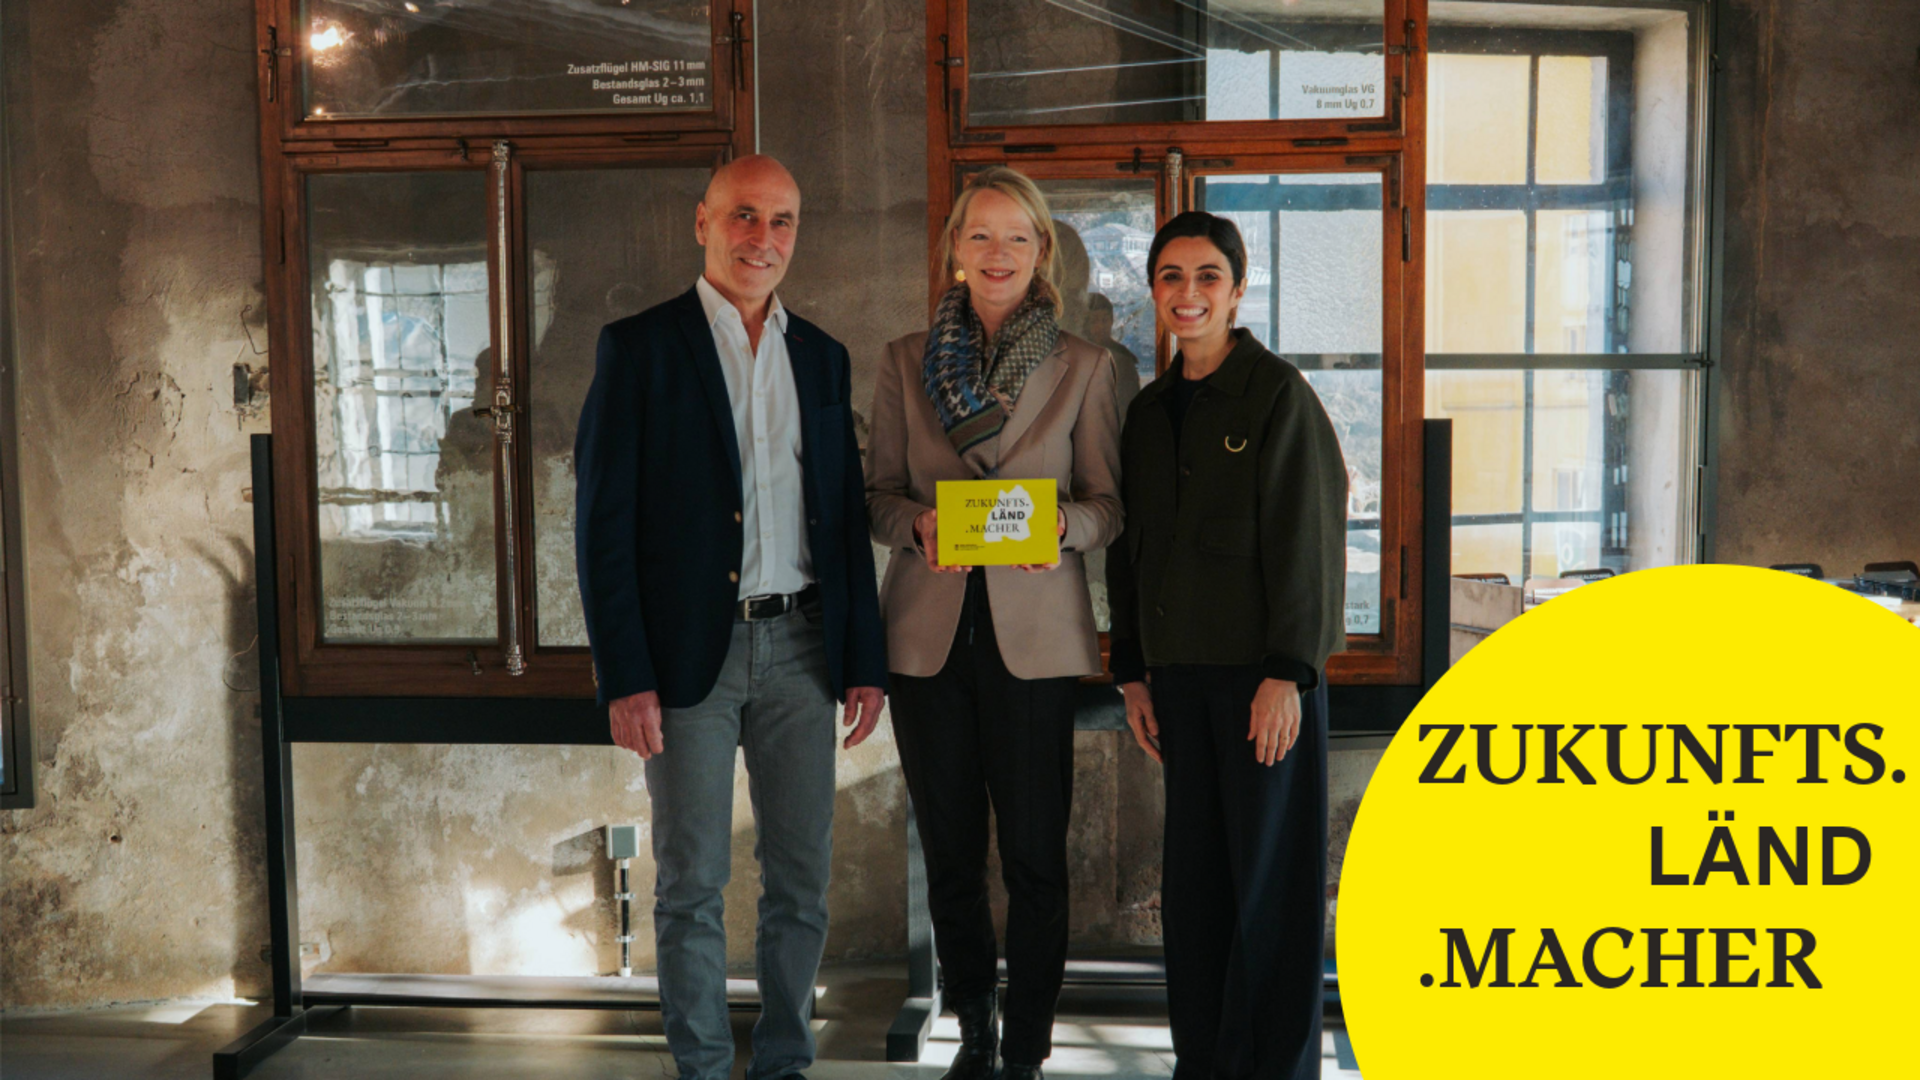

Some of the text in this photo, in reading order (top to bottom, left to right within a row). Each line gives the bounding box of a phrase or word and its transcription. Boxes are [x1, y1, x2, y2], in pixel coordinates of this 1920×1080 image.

[567, 62, 628, 76] Zusatzflügel
[631, 60, 670, 72] HM-SIG
[592, 78, 660, 91] Bestandsglas
[1301, 83, 1375, 96] Vakuumglas VG
[613, 92, 705, 106] Gesamt Ug ca. 1,1
[1316, 99, 1322, 109] 8
[1324, 101, 1342, 109] mm
[1344, 99, 1358, 110] Ug
[965, 498, 1030, 508] ZUKUNFTS.
[991, 508, 1026, 521] LÄND
[965, 523, 1020, 534] .MACHER
